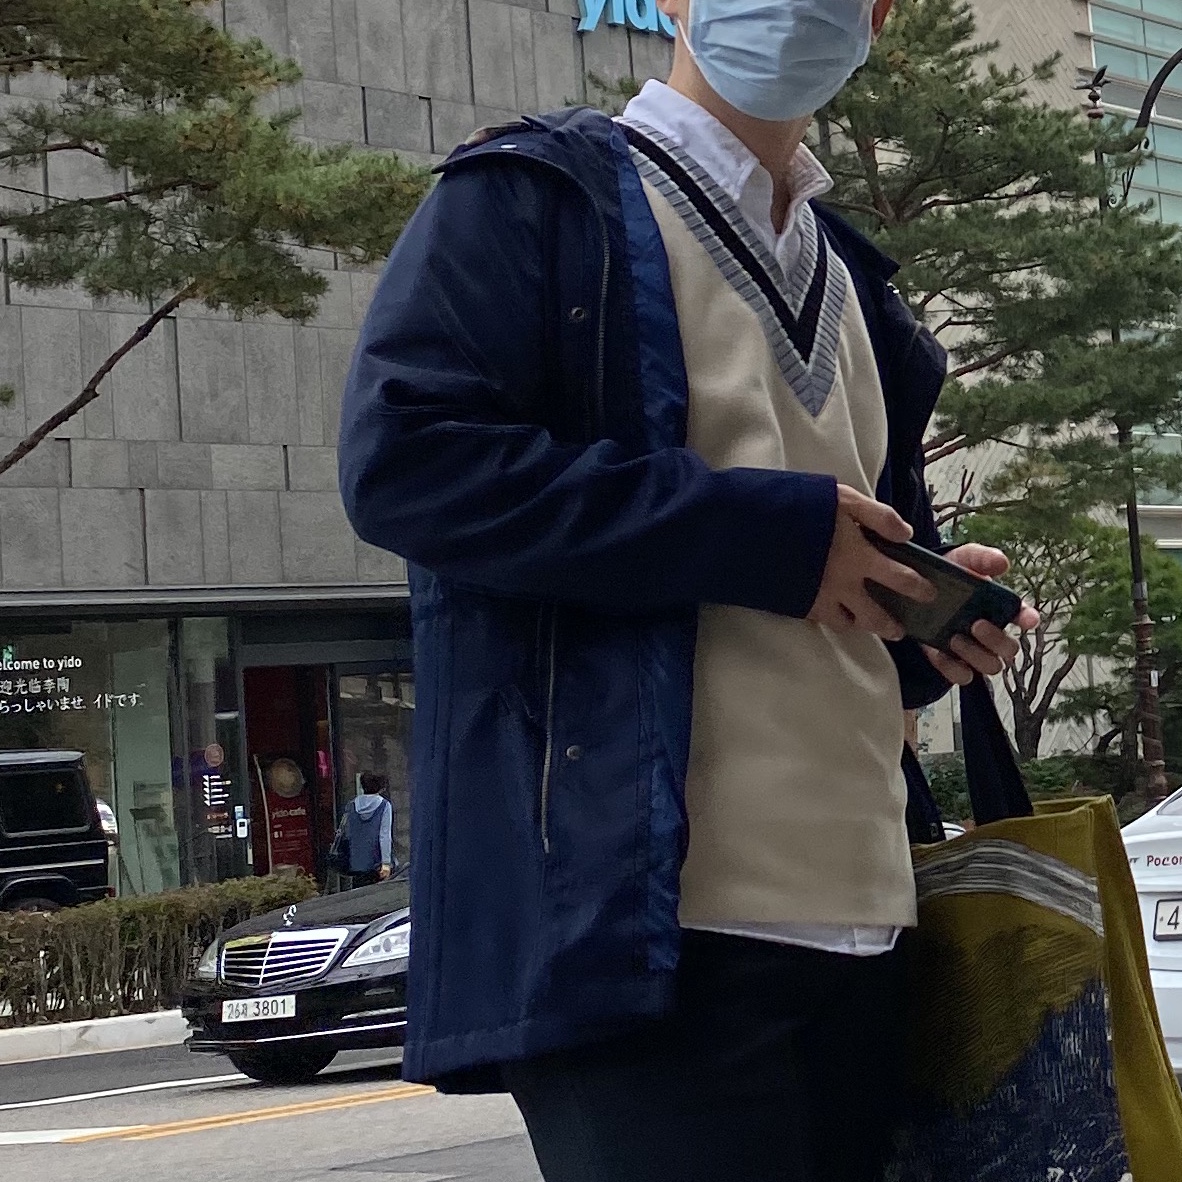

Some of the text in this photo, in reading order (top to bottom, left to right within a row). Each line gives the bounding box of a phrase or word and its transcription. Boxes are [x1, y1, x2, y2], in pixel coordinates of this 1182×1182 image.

[43, 657, 55, 669] to
[57, 655, 82, 671] yido
[252, 998, 286, 1017] 3801
